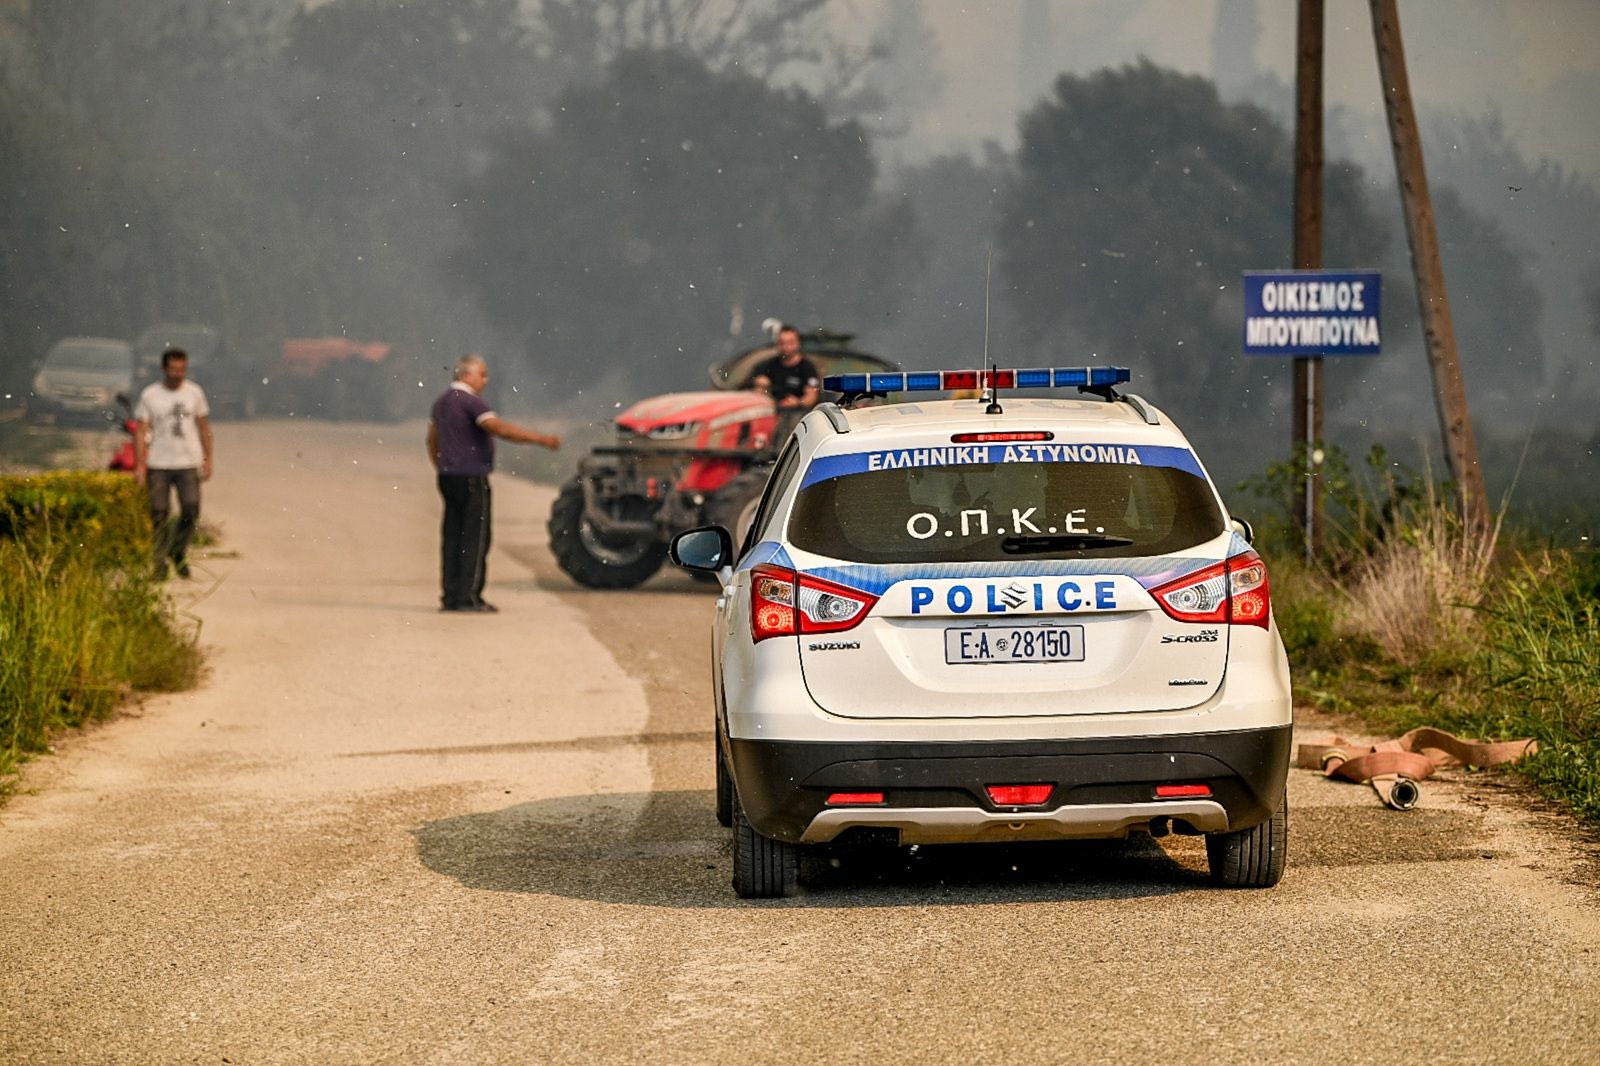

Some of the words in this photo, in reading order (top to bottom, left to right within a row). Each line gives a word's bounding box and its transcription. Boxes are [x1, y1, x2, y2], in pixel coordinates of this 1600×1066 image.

[1262, 281, 1365, 312] ΟΙΚΙΣΜΟΣ
[1246, 316, 1380, 346] ΜΠΟΥΜΠΟΥΝΑ
[868, 447, 989, 471] ΕΛΛΗΝΙΚΗ
[1003, 445, 1141, 464] ΑΣΤΥΝΟΜΙΑ
[906, 507, 1105, 539] Ο.Π.Κ.Ε.
[911, 581, 1117, 614] POLICE
[808, 641, 861, 651] SUZUKI
[1011, 630, 1071, 658] 28150
